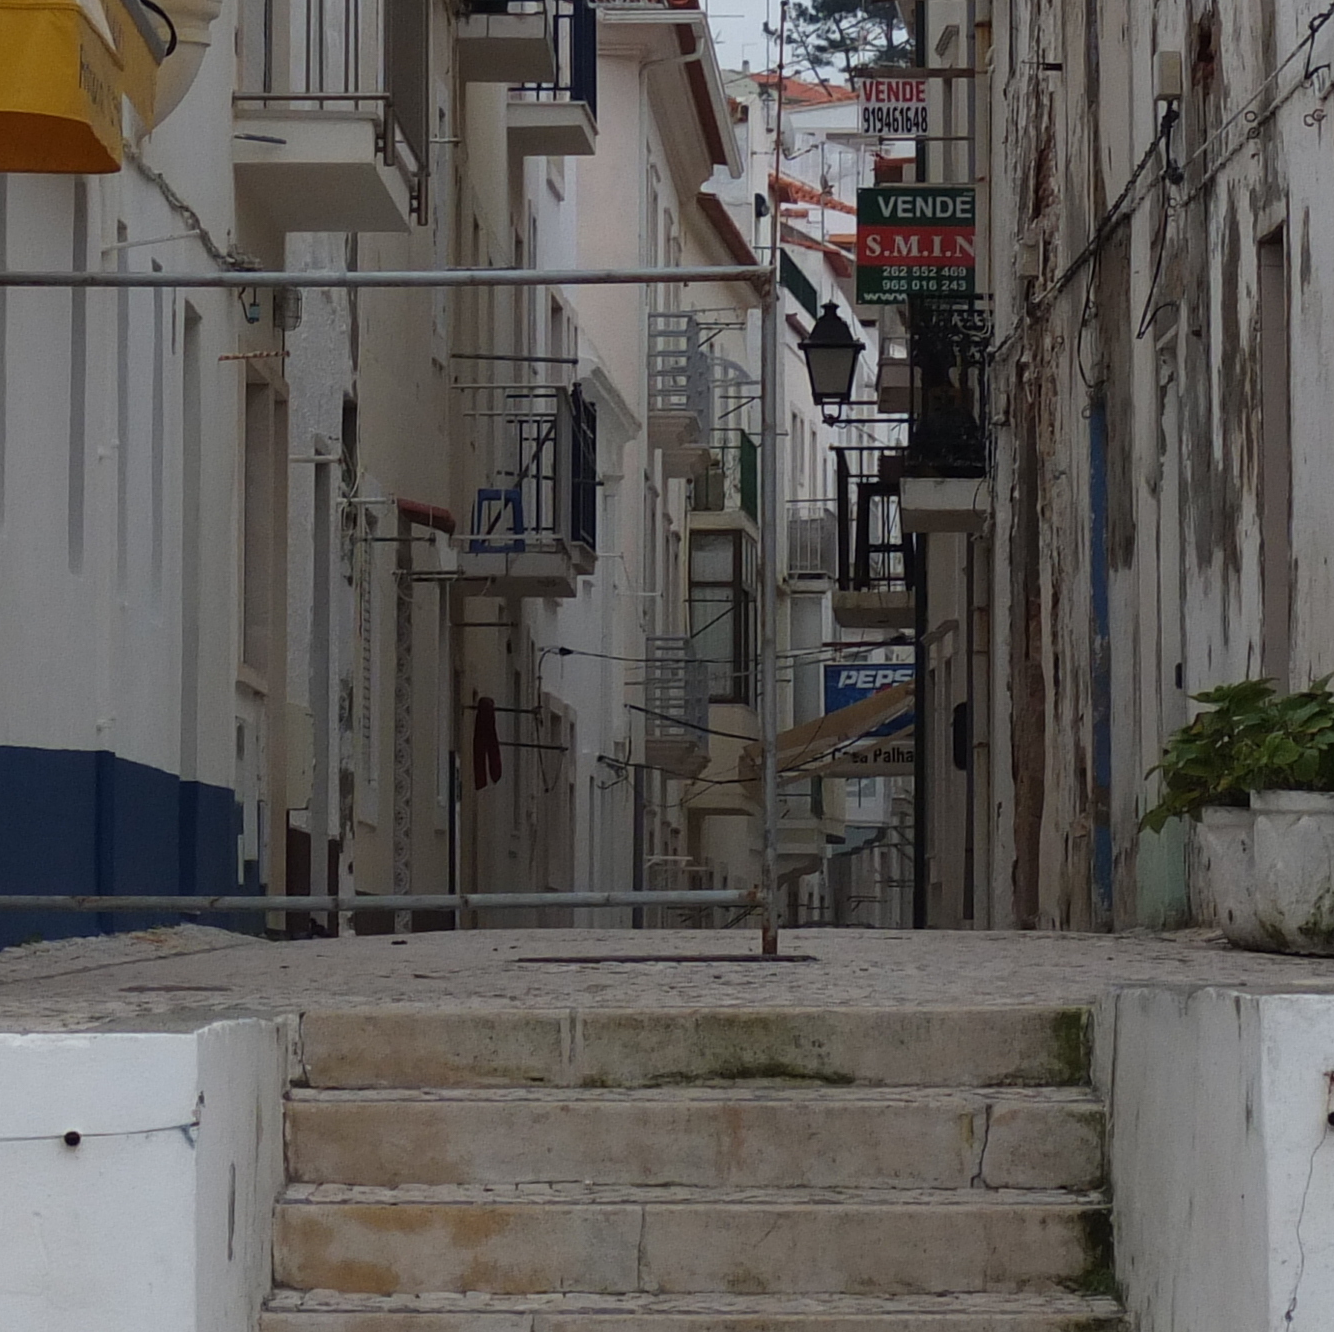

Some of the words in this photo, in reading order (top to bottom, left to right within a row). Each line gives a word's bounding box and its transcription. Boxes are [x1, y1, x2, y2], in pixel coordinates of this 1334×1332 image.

[863, 81, 926, 102] VENDE
[863, 106, 927, 133] 919461648
[877, 196, 972, 217] VENDE
[883, 267, 907, 276] 262
[912, 267, 937, 276] 552
[941, 267, 966, 276] 469
[882, 280, 907, 290] 965
[912, 280, 937, 290] 016
[941, 280, 966, 290] 243
[838, 670, 915, 688] PEPS
